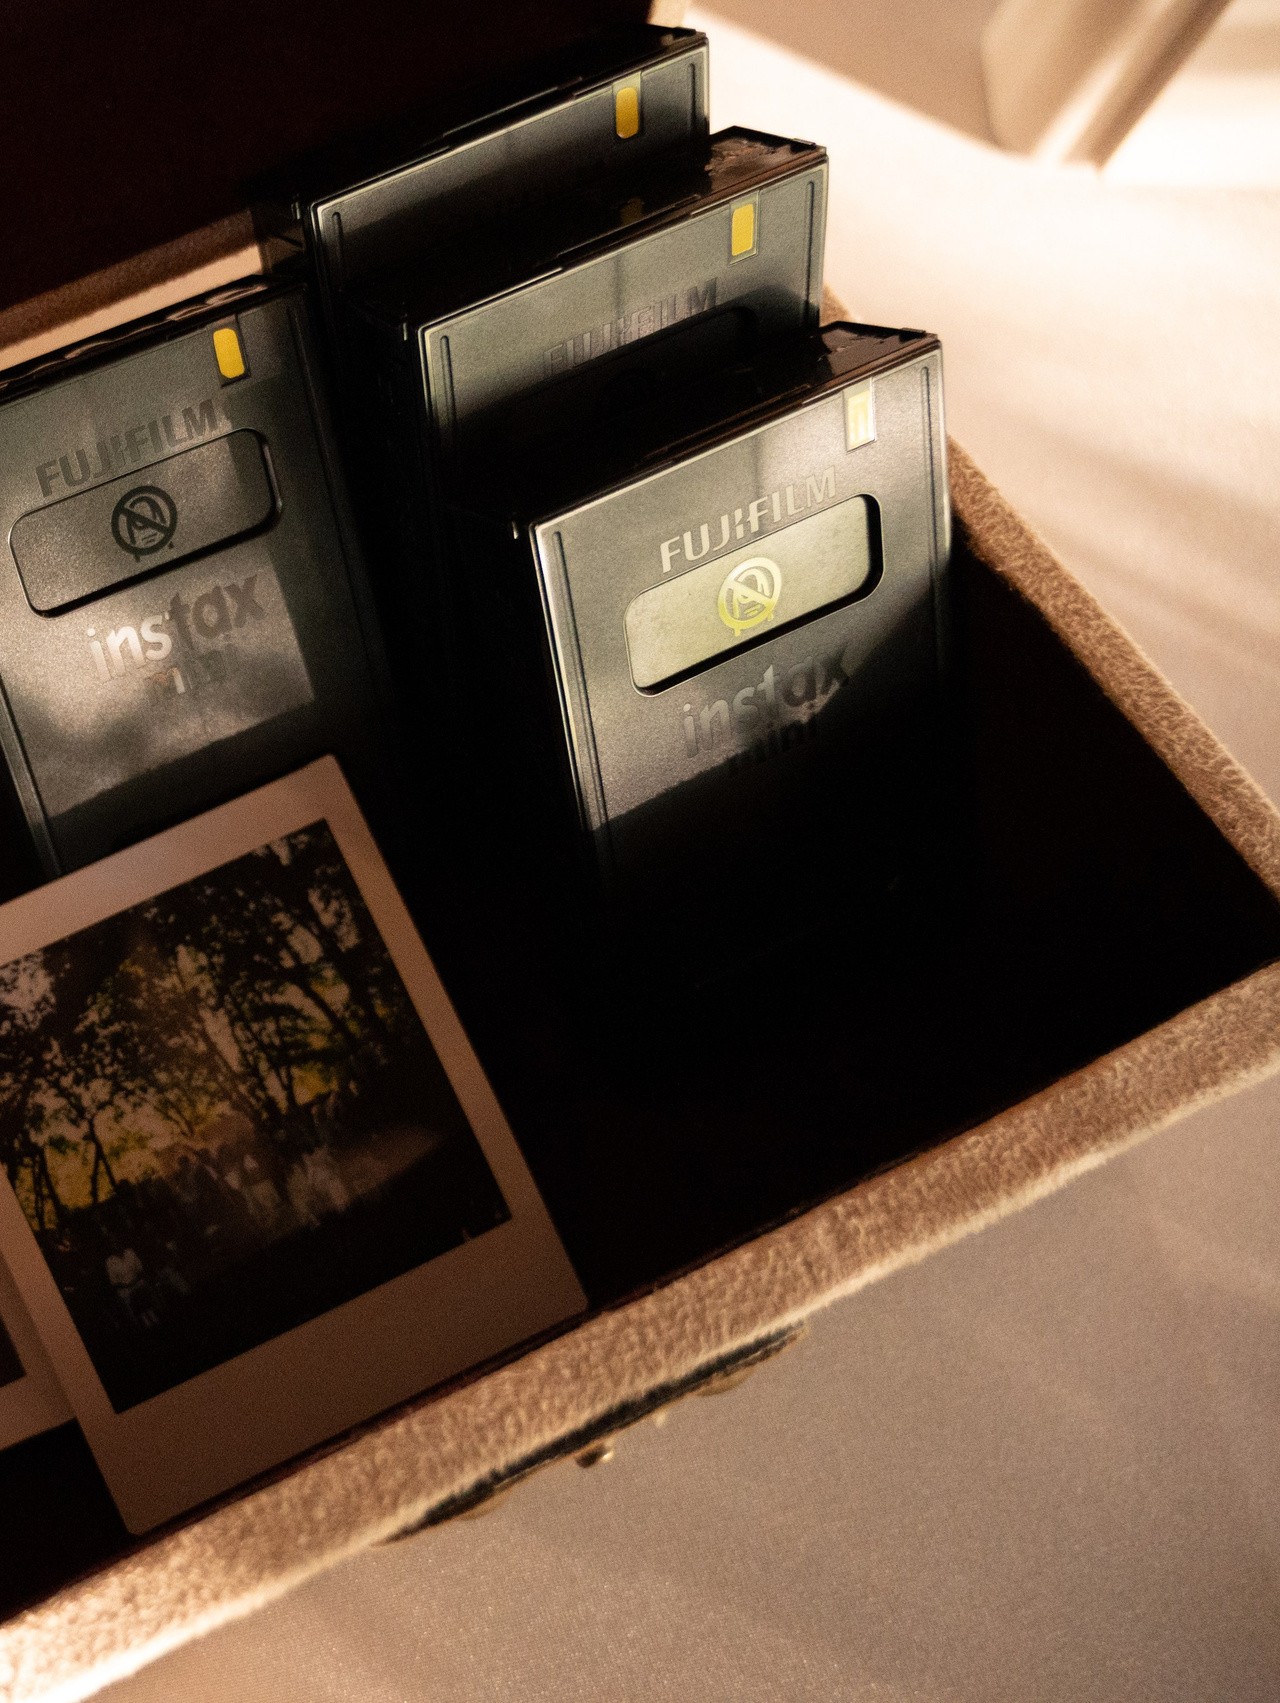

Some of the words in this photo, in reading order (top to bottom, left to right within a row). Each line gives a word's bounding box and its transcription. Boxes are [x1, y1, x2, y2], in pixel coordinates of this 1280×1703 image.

[35, 399, 219, 498] FUJIFILM
[660, 465, 837, 574] FUJIFILM
[86, 574, 268, 685] instax
[682, 641, 852, 759] instax
